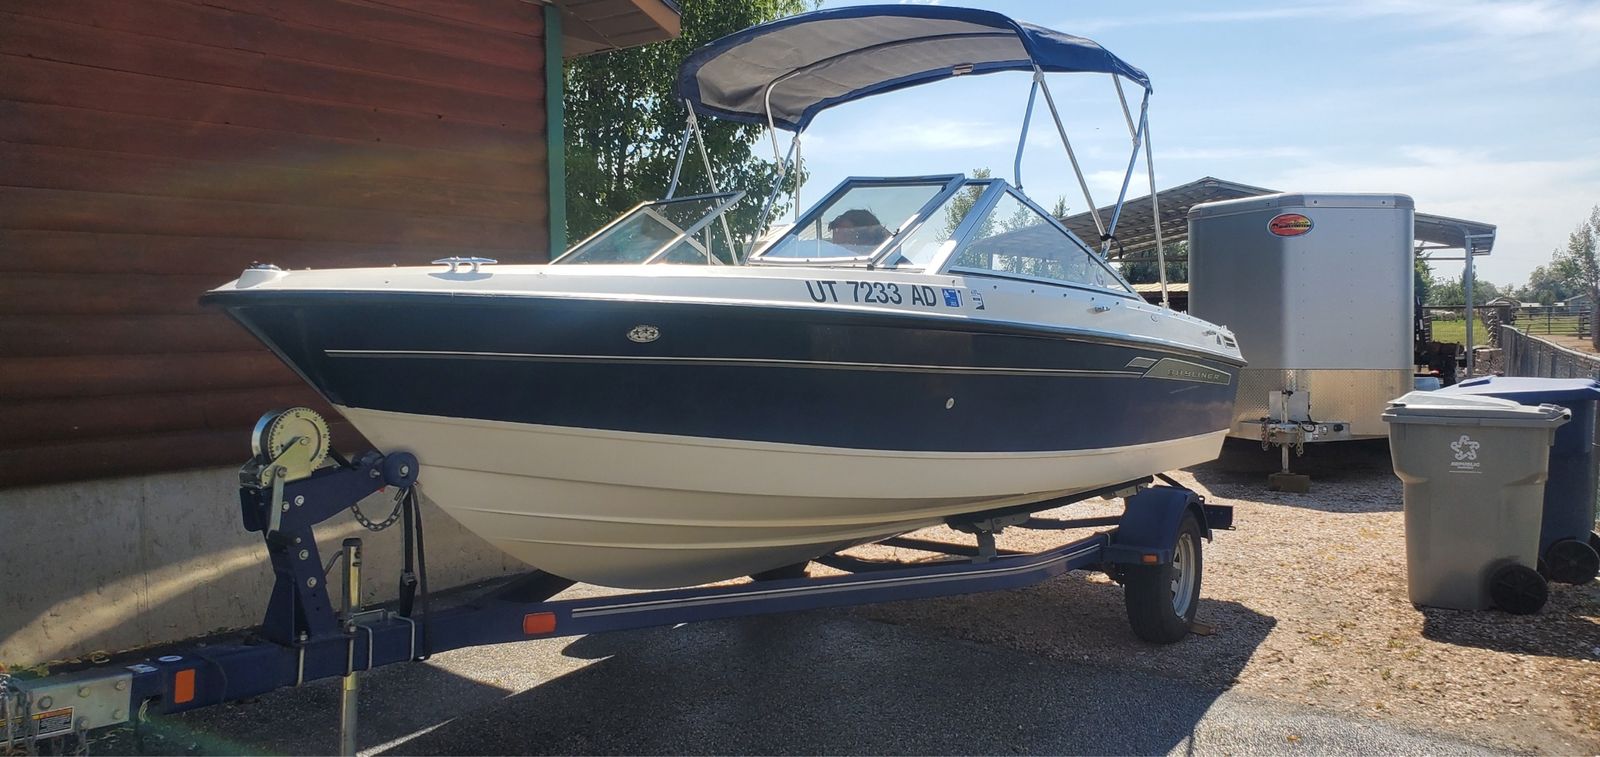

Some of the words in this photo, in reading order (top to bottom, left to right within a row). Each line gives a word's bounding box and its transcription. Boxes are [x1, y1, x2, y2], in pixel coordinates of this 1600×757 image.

[805, 280, 839, 303] UT
[846, 281, 902, 305] 7233
[912, 285, 937, 306] AD
